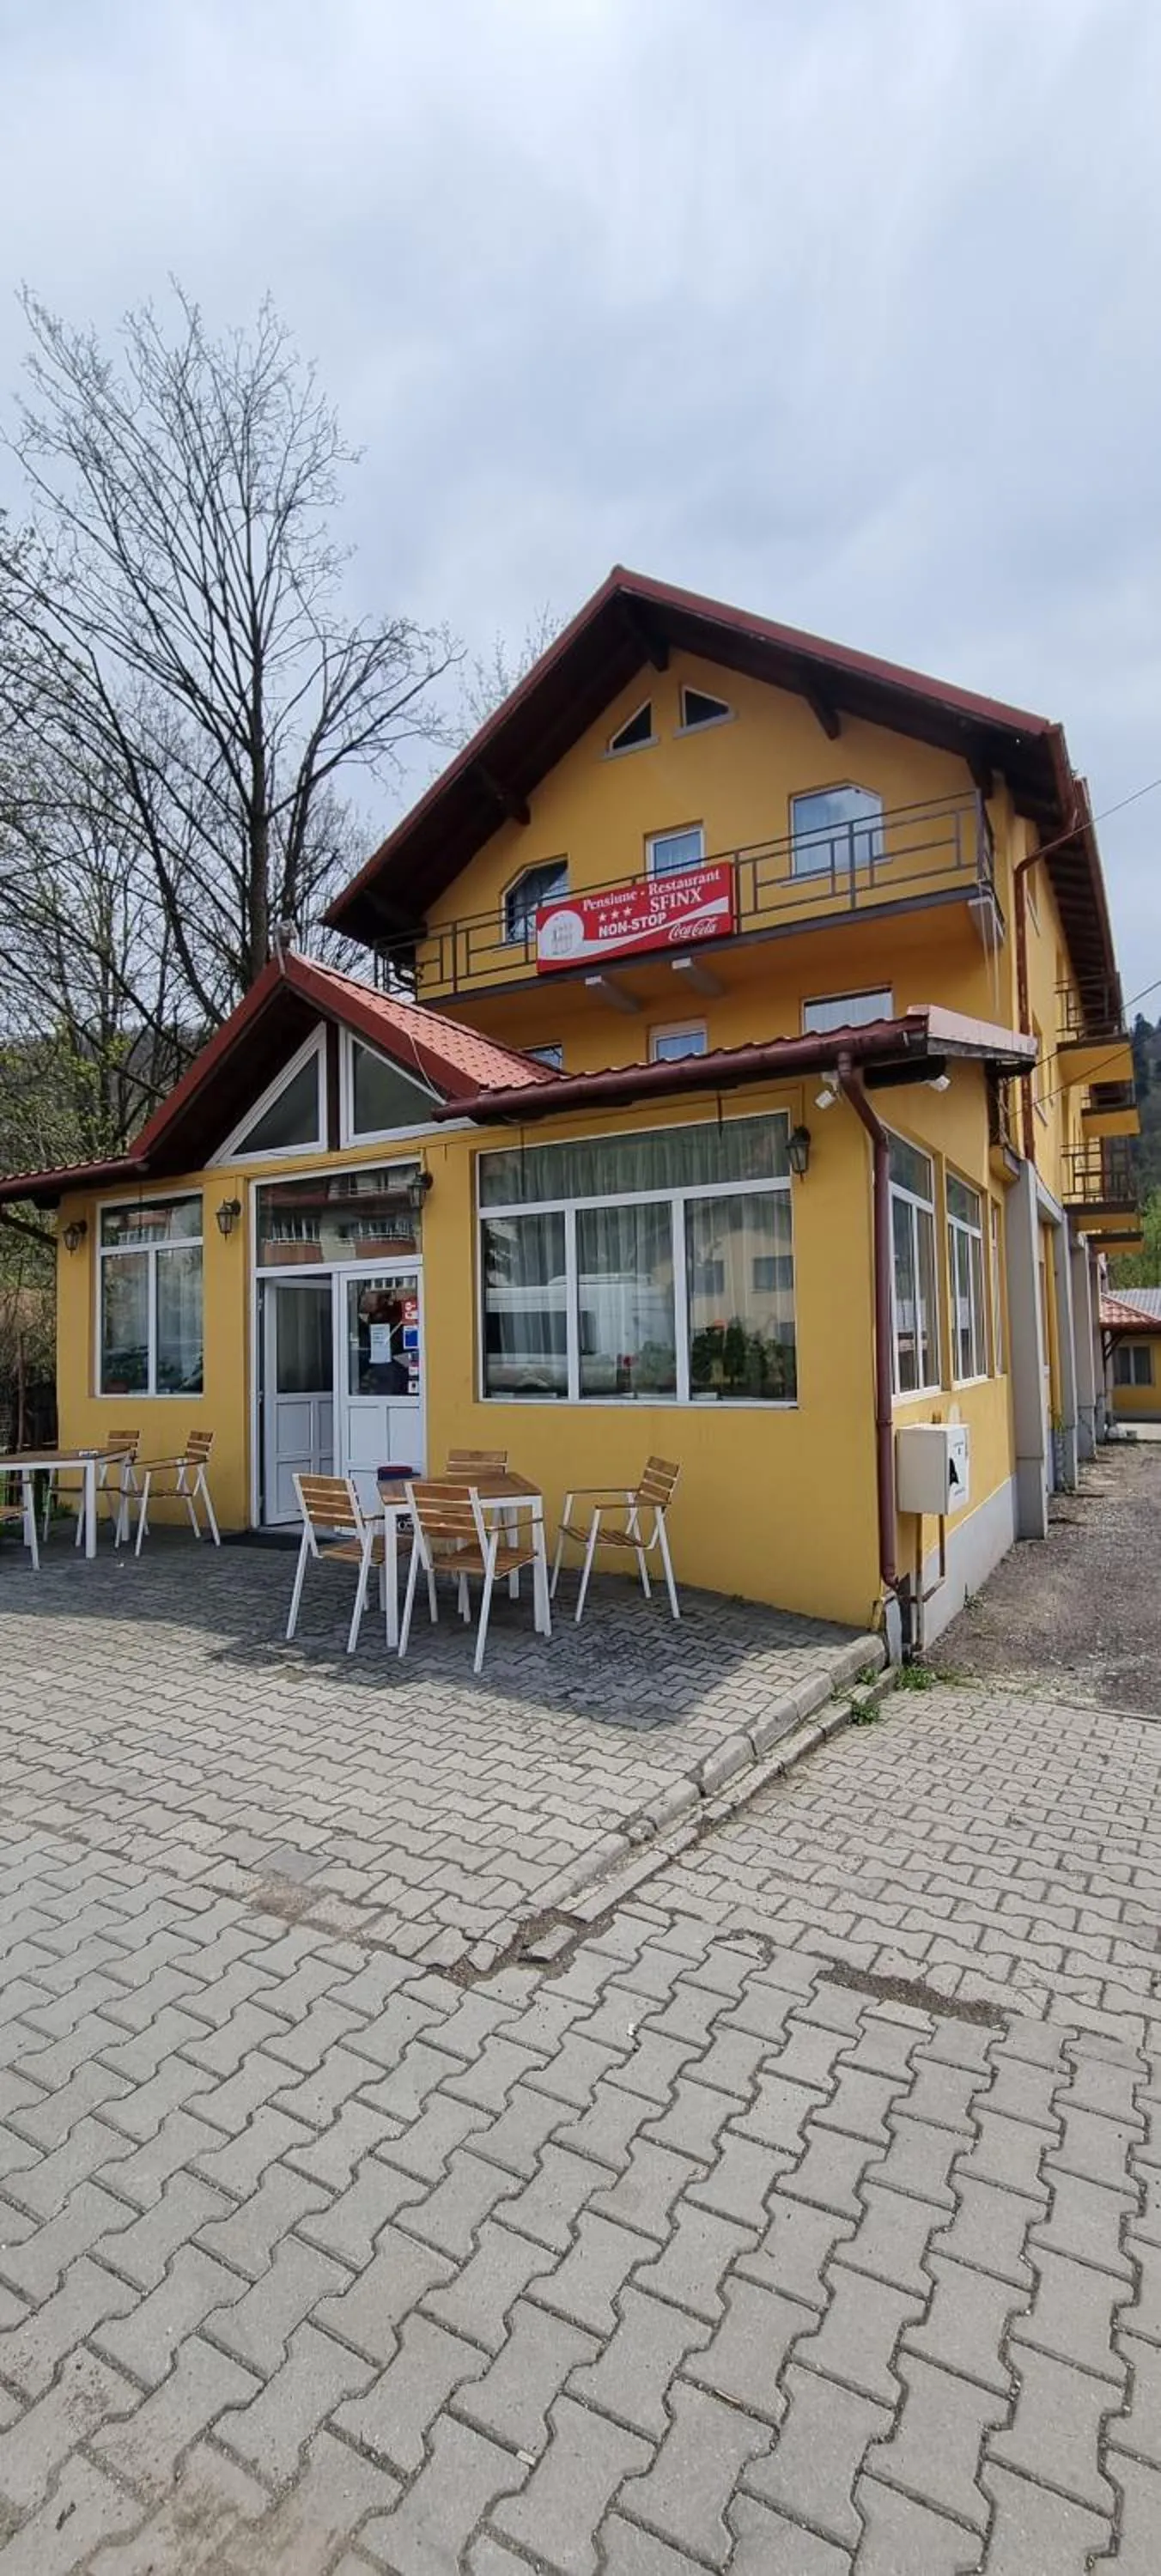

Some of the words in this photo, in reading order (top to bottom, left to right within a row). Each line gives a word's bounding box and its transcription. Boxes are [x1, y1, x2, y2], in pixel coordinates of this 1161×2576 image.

[583, 890, 636, 912] Pensiune
[648, 870, 720, 896] Restaurant
[650, 887, 702, 913] SFINX
[599, 912, 666, 938] NON-STOP
